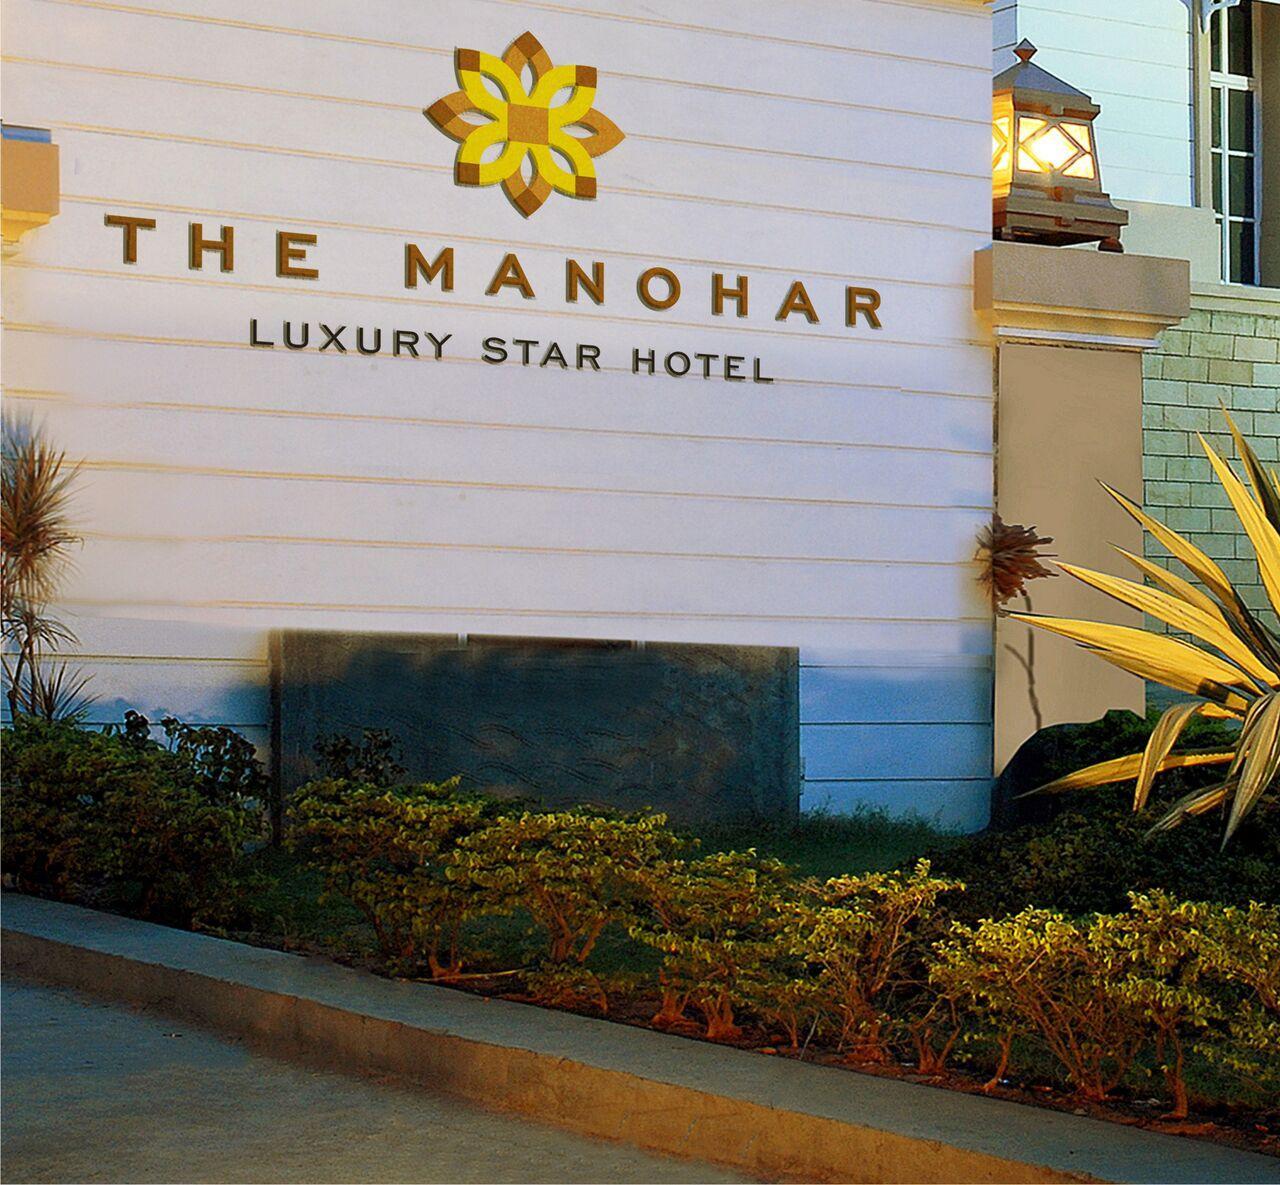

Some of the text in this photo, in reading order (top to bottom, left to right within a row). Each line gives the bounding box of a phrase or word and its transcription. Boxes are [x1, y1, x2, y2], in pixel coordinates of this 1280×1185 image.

[104, 214, 884, 330] THE MANOHAR
[249, 318, 775, 383] LUXURY STAR HOTEL
